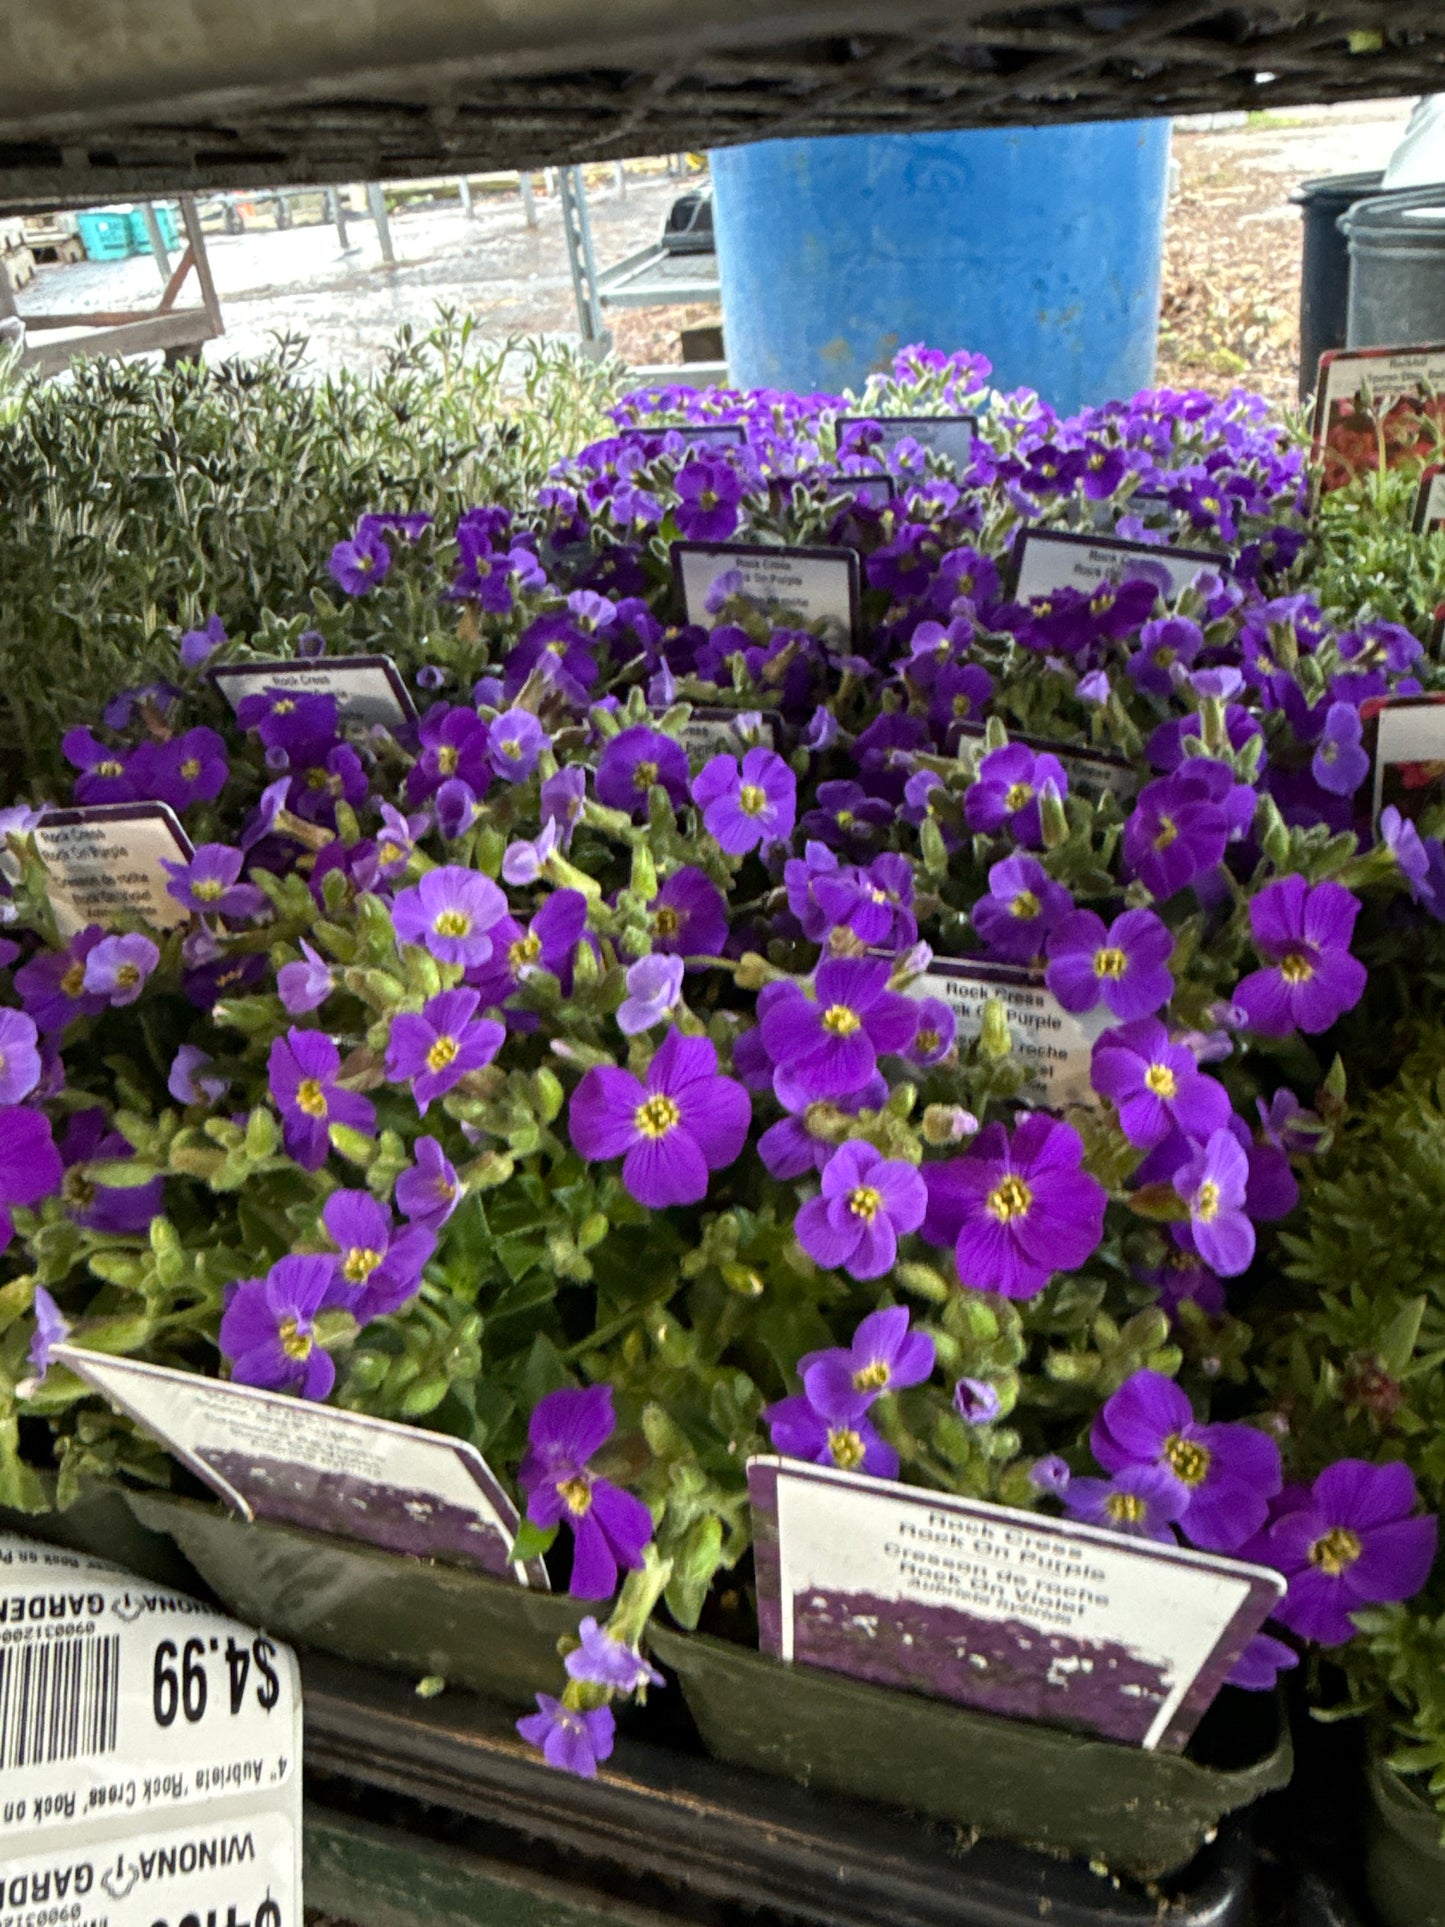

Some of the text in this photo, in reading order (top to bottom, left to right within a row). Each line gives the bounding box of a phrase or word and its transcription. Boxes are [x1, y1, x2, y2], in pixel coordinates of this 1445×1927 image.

[946, 981, 988, 1000] Rock
[1006, 1008, 1062, 1031] Purple
[899, 1520, 1106, 1581] Rock On Purple
[928, 1511, 1083, 1560] Rock Cress
[884, 1541, 1110, 1608] Cresson de roche
[899, 1560, 1085, 1617] Rock On Violet
[153, 1628, 281, 1728] $4.99
[3, 1799, 26, 1824] on
[34, 1791, 77, 1824] Rock
[139, 1831, 256, 1881] WINONA
